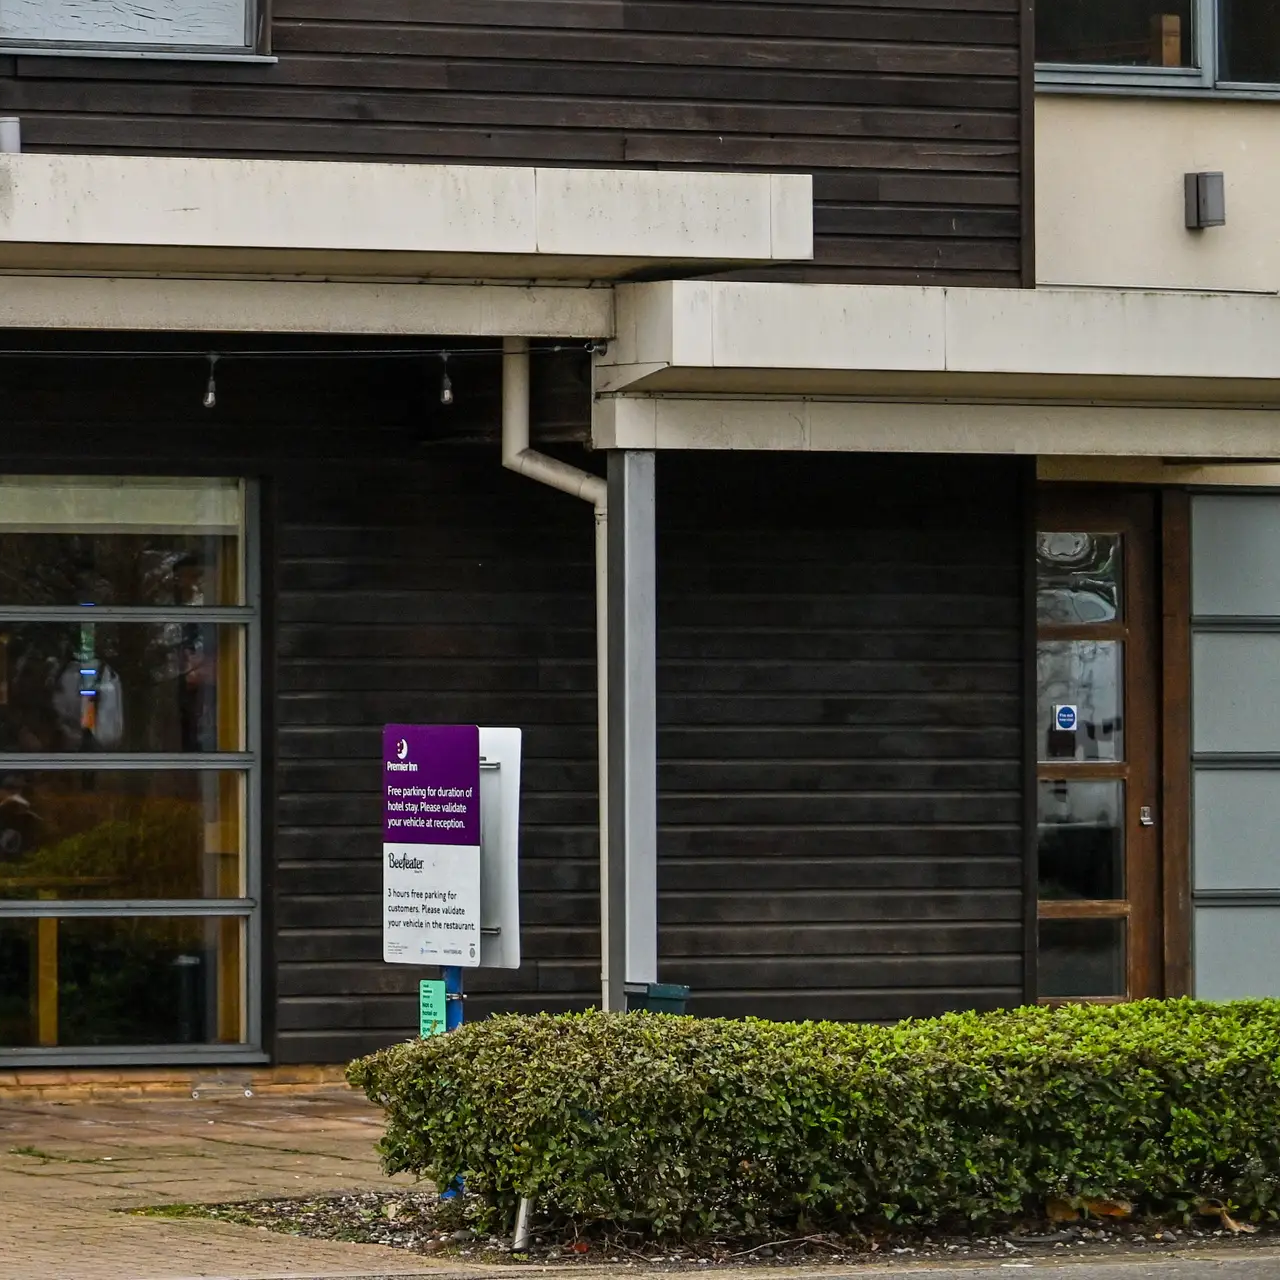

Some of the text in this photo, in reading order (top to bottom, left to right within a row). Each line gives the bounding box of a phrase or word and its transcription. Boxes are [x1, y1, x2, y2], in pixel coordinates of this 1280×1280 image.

[387, 761, 418, 772] Premier Inn
[387, 785, 473, 799] Free parking for duration of
[387, 801, 467, 814] hotel stay. Please validate
[387, 816, 465, 830] your vehicle at reception.
[388, 852, 425, 871] Beefeater
[388, 888, 457, 902] 3 hours free parking for
[388, 904, 465, 915] customers. Please validate
[388, 918, 476, 931] your vehicle in the restaurant.
